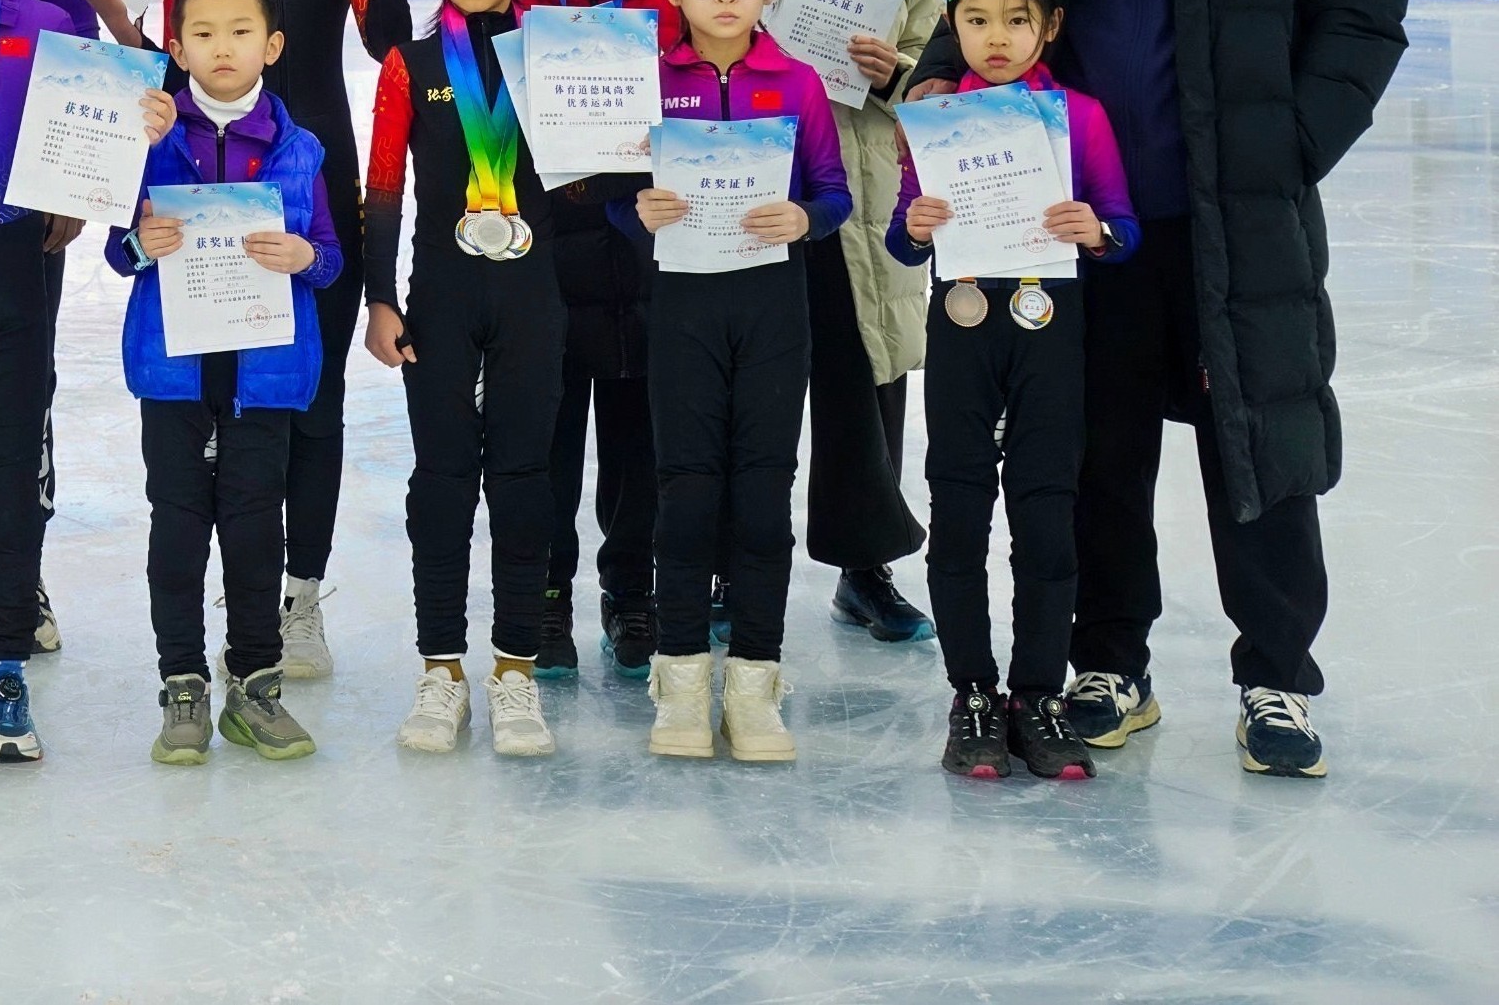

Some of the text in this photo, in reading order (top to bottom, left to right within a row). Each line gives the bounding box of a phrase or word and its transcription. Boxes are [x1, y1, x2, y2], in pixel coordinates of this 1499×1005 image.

[555, 84, 635, 95] 体育道德风尚奖
[567, 98, 624, 108] 优秀运动员
[64, 101, 119, 124] 获奖证书
[958, 150, 1014, 173] 获奖证书
[701, 176, 755, 189] 获奖证书
